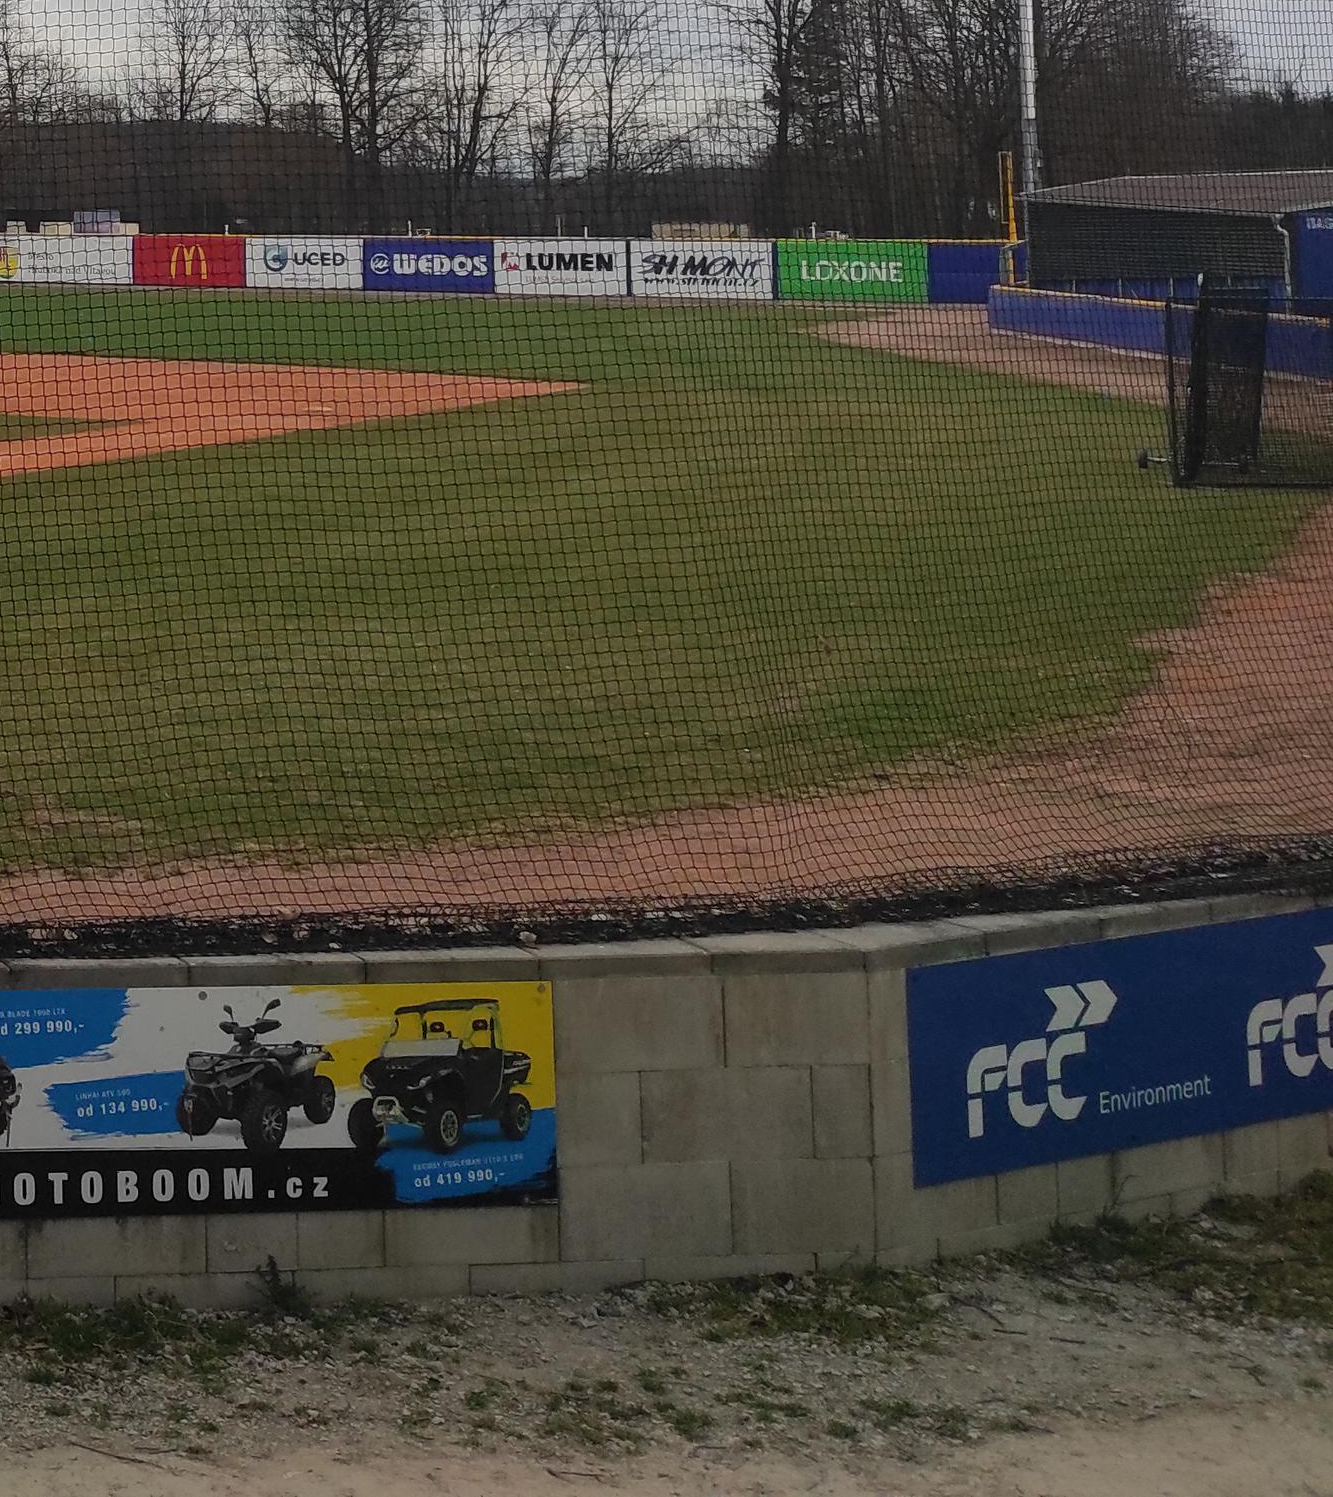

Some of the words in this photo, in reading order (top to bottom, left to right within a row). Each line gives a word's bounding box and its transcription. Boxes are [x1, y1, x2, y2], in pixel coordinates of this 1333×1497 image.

[293, 251, 346, 267] UCED
[393, 252, 488, 277] WEDOS
[526, 252, 614, 272] LUMEN
[800, 259, 904, 283] LOXONE
[14, 1021, 41, 1035] 299
[46, 1019, 84, 1034] 990,-
[966, 1031, 1087, 1139] FCC
[1099, 1074, 1212, 1115] Environment
[76, 1103, 94, 1118] od
[100, 1100, 126, 1115] 134
[131, 1097, 169, 1112] 990,-
[414, 1174, 431, 1188] od
[436, 1171, 462, 1185] 419
[467, 1168, 505, 1184] 990,-
